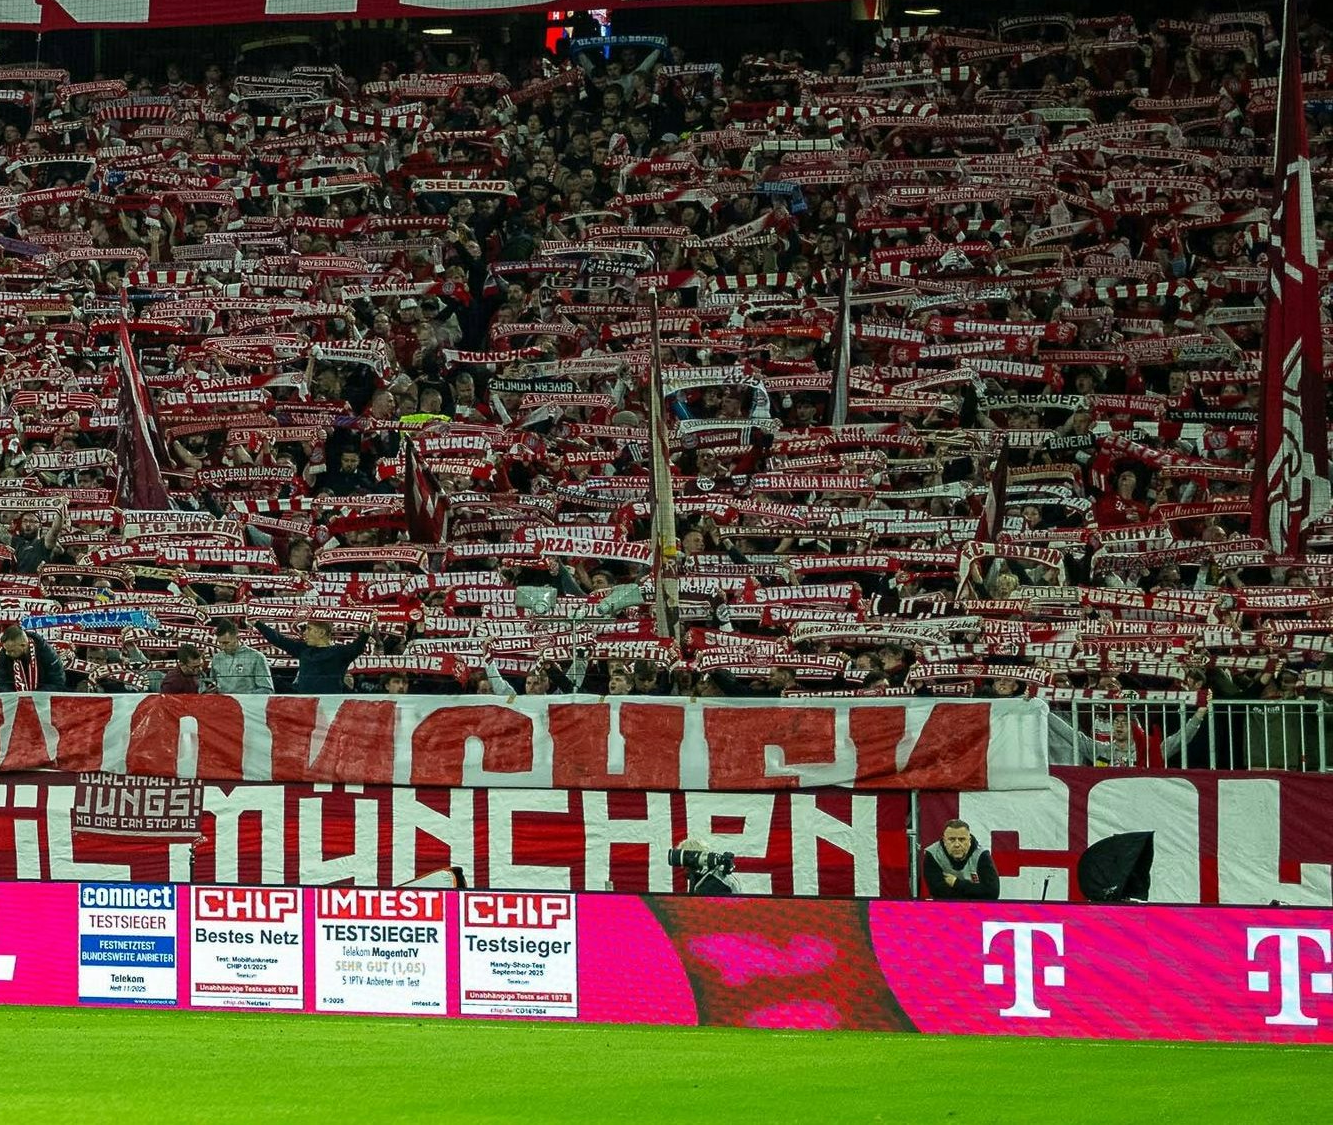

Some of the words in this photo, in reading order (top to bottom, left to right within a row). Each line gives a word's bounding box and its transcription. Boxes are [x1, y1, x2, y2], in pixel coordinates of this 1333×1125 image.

[424, 179, 507, 193] SEELAND
[952, 320, 1046, 337] SÜDKURVE
[918, 339, 1006, 358] SÜDKURVE
[960, 358, 1045, 379] SÜDKURVE
[978, 395, 1083, 410] ECKENBAUER
[566, 451, 616, 462] BAYERN
[249, 466, 293, 478] MÜNCHEN
[770, 477, 819, 488] BAVARIA
[821, 477, 859, 488] HANAU
[525, 526, 615, 542] SÜDKURVE
[319, 552, 331, 561] FC
[333, 551, 370, 560] BAYERN
[372, 550, 417, 558] MÜNCHEN
[452, 543, 535, 556] SÜDKURVE
[593, 542, 651, 559] BAYERN
[790, 556, 889, 570] SÜDKURVE
[755, 584, 854, 601] SÜDKURVE
[248, 606, 293, 618] BAYERN
[312, 608, 370, 621] MÜNCHEN
[63, 632, 117, 645] BAYERN
[773, 654, 844, 669] MÜNCHEN
[76, 786, 201, 817] JUNGS!
[76, 815, 91, 826] NO
[120, 818, 143, 828] CAN
[146, 818, 177, 829] STOP
[181, 818, 196, 829] US
[83, 886, 172, 908] connect
[322, 890, 440, 917] IMTEST
[198, 890, 295, 920] CHIP
[468, 895, 569, 925] CHIP
[89, 914, 167, 929] TESTSIEGER
[195, 928, 254, 944] Bestes
[260, 929, 299, 945] Netz
[322, 925, 439, 944] TESTSIEGER
[99, 940, 156, 951] FESTNETZTEST
[343, 946, 370, 957] Telekom
[371, 947, 419, 959] MagentaTV
[465, 935, 572, 957] Testsieger
[81, 951, 135, 962] BUNDESWEITE
[136, 953, 174, 963] ANBIETER
[335, 960, 363, 972] SEHR
[366, 961, 389, 973] GUT
[391, 962, 426, 975] (1,05)
[492, 969, 527, 977] September
[528, 969, 545, 977] 2025
[111, 974, 145, 984] Telekom
[406, 978, 420, 987] Test
[199, 984, 243, 994] Unabhängige
[244, 985, 262, 994] Tests
[263, 986, 277, 994] seit
[470, 991, 515, 1002] Unabhängige
[516, 993, 535, 1001] Tests
